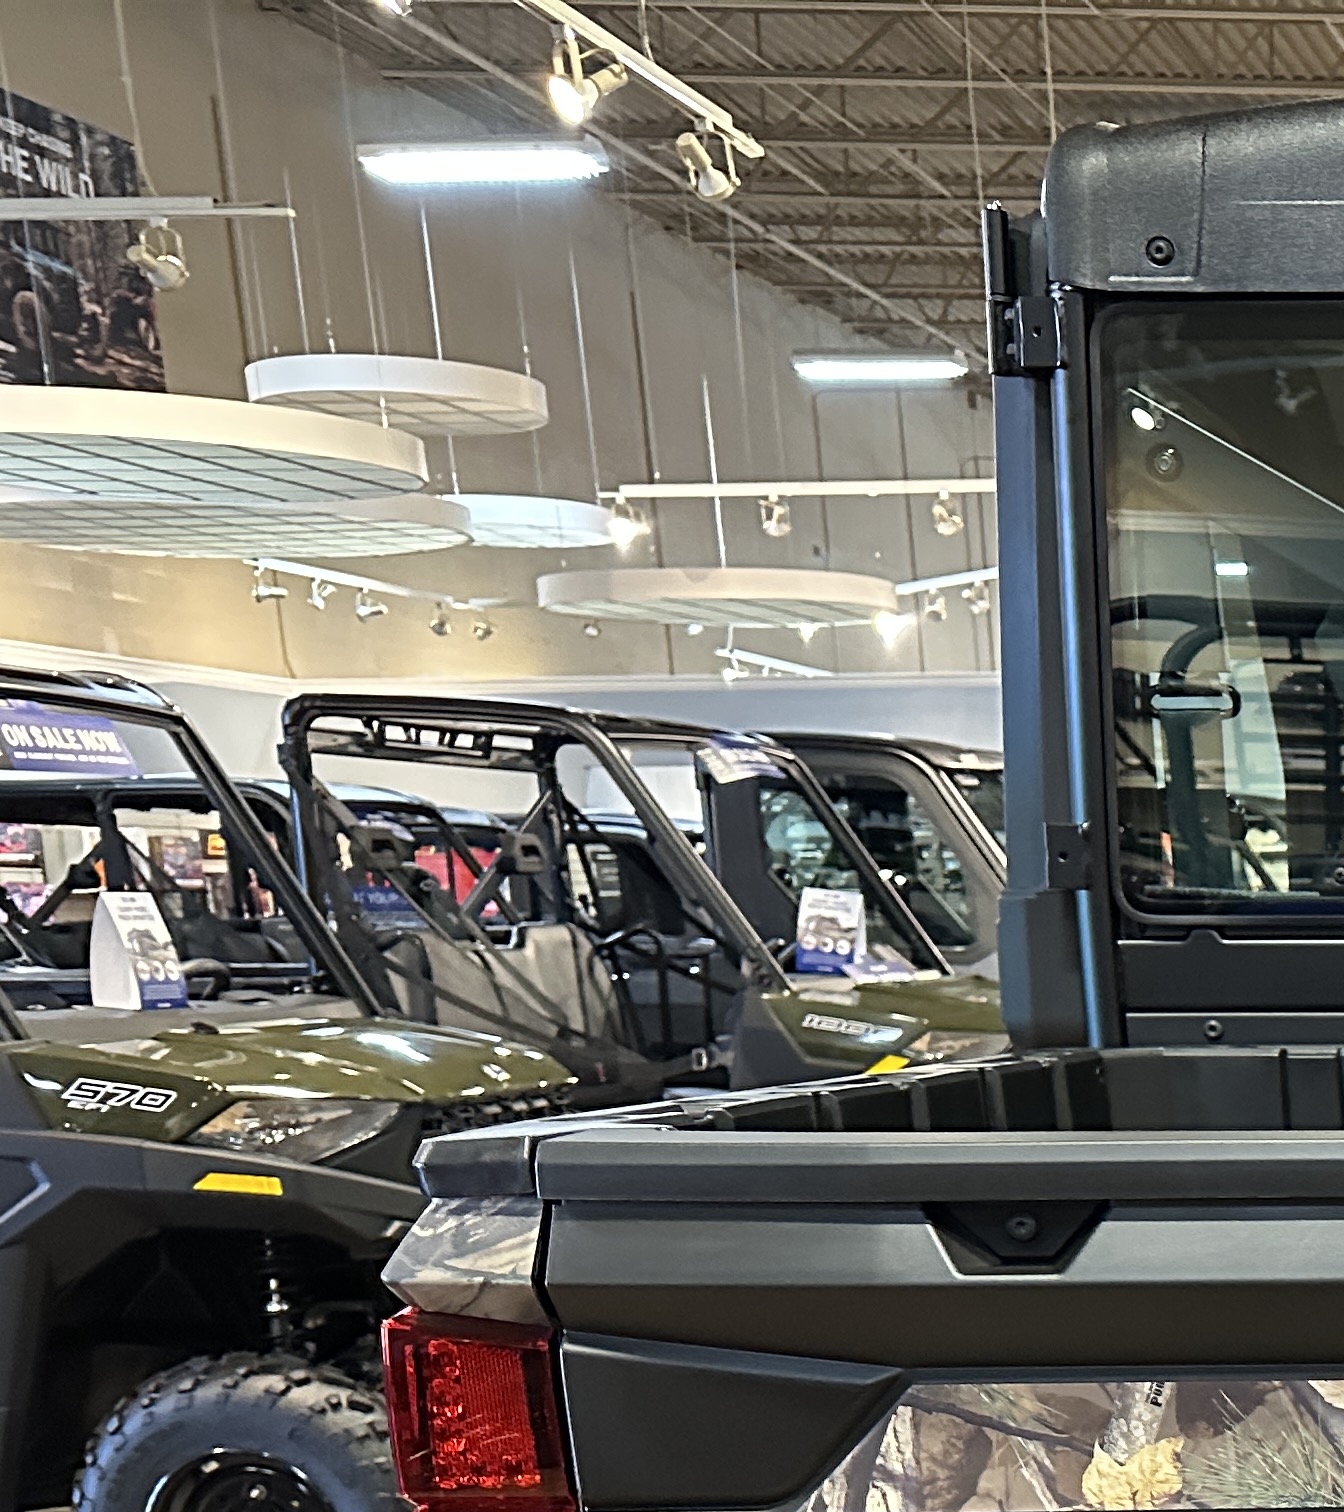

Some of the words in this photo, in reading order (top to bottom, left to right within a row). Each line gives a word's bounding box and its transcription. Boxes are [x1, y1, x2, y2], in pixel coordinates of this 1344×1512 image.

[0, 140, 33, 182] HE
[34, 154, 95, 198] WILD
[1, 723, 34, 747] ON
[29, 725, 83, 750] SALE
[76, 728, 122, 753] NOW
[61, 1077, 178, 1112] 570
